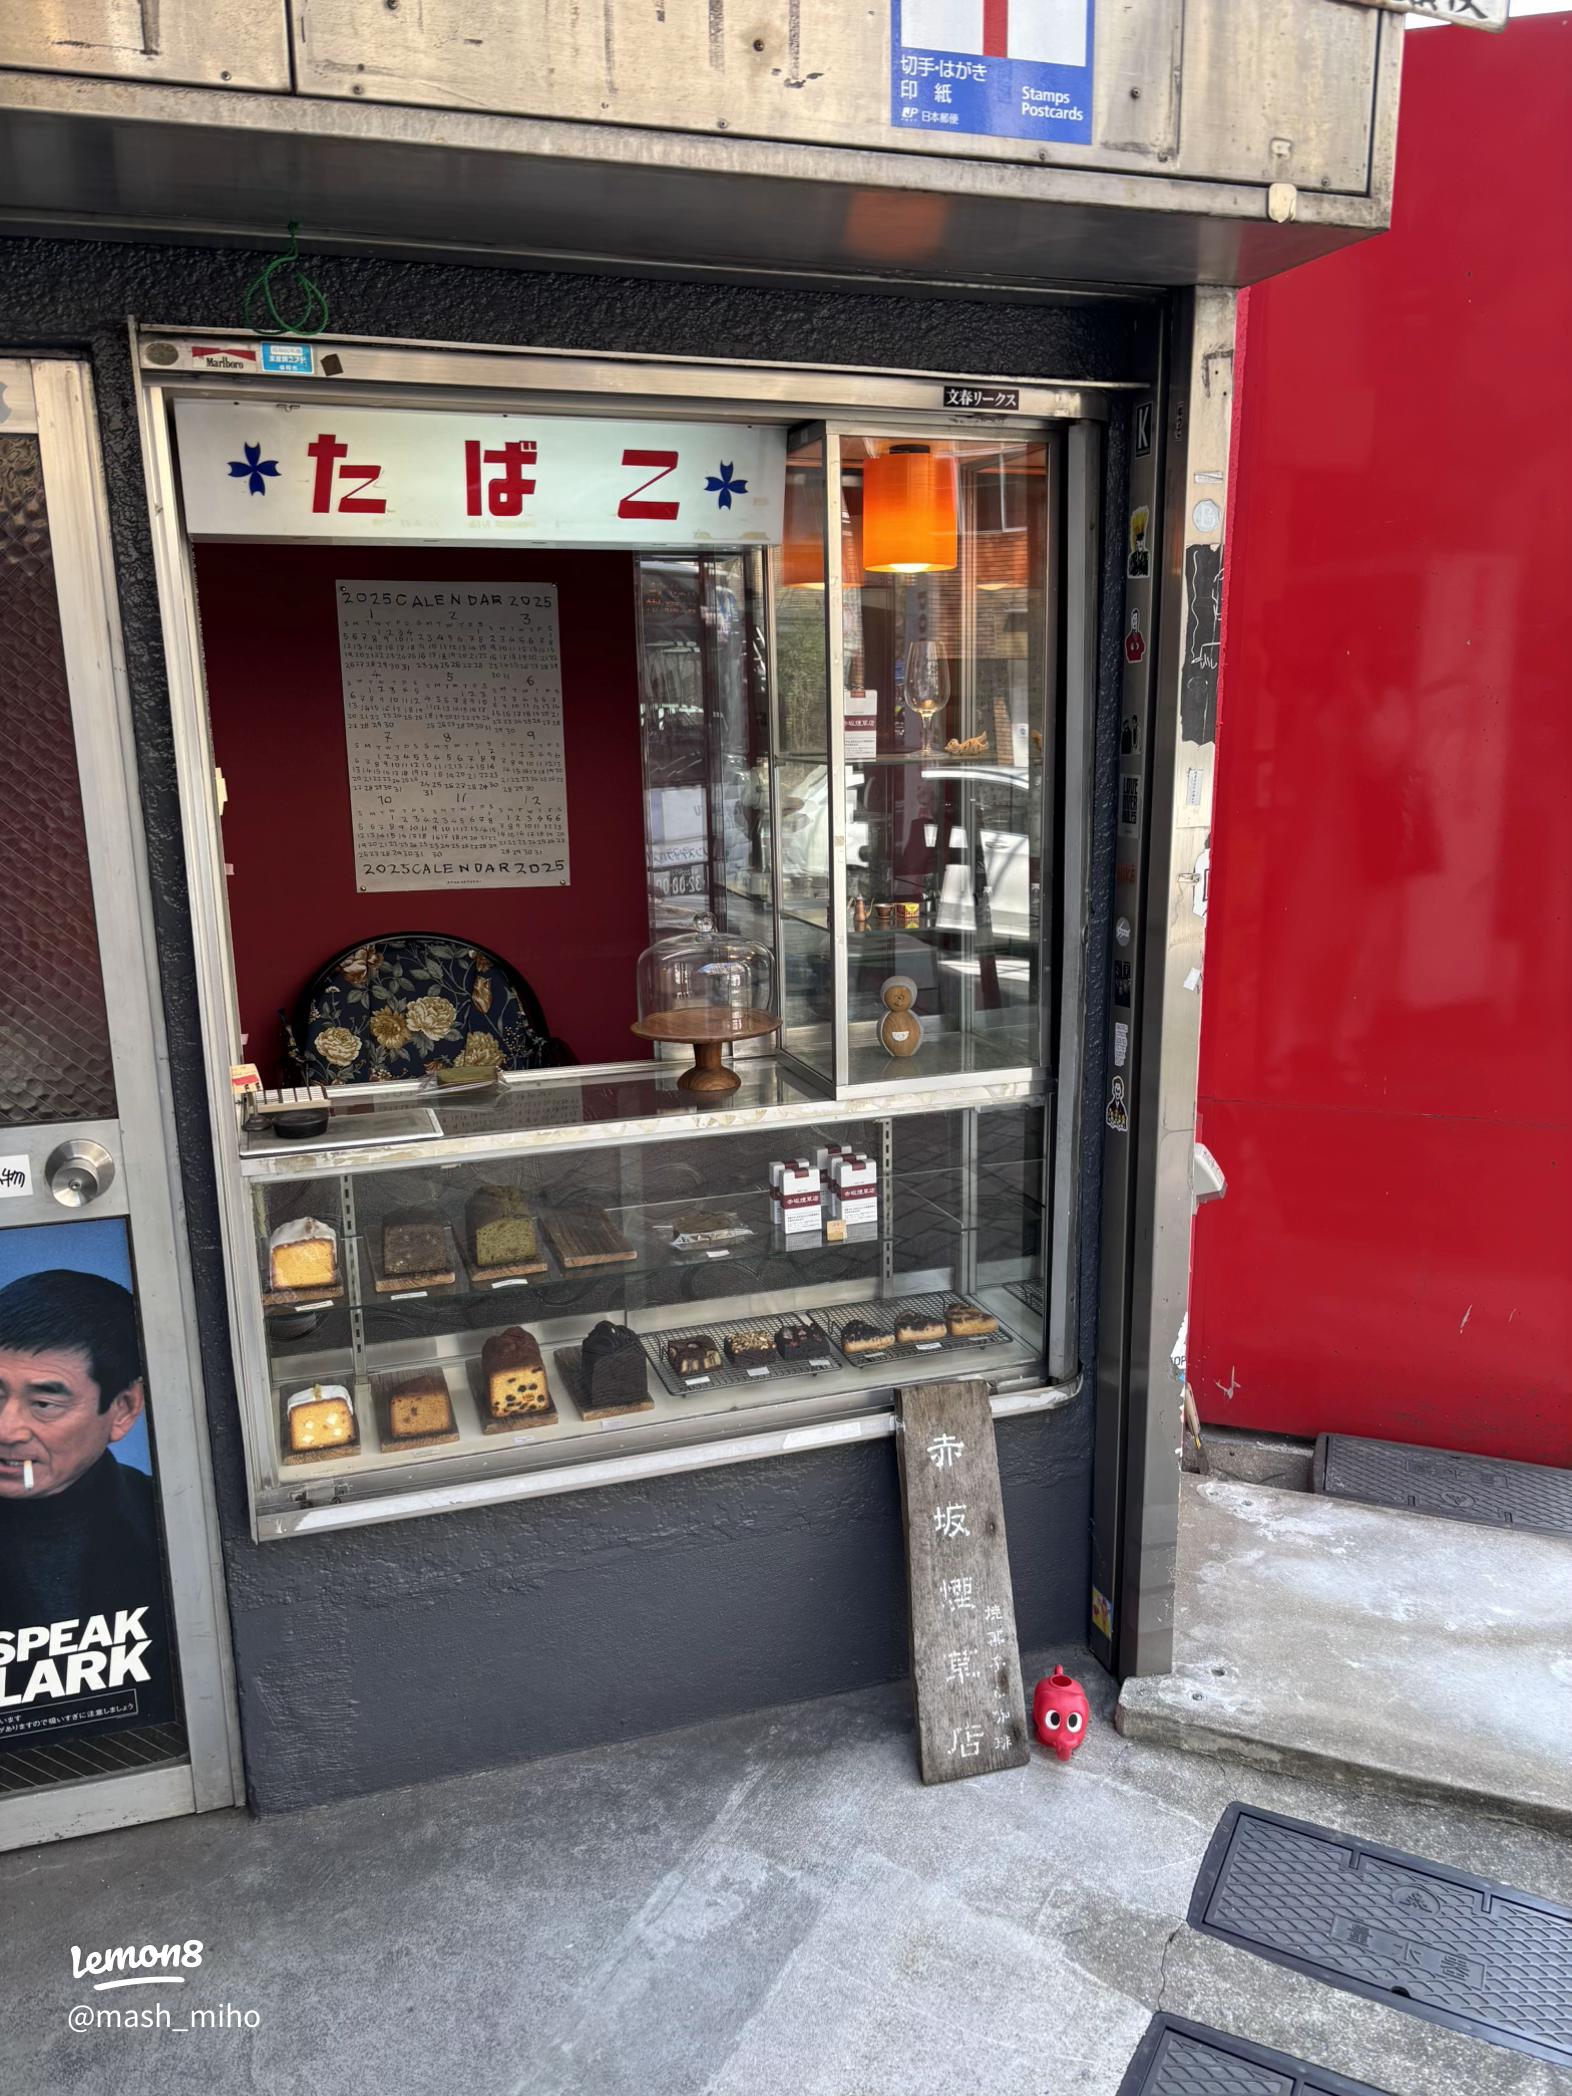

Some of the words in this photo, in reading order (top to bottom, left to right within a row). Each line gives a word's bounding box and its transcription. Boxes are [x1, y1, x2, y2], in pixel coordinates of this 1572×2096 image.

[900, 54, 987, 82] 切手・はがき
[1022, 86, 1070, 104] Stamps
[921, 110, 959, 125] 日本郵便
[1021, 102, 1084, 121] Postcards
[206, 357, 244, 370] Marlboro
[945, 389, 1017, 407] 文春リークス
[520, 613, 531, 625] 3
[447, 672, 454, 682] 5
[526, 675, 535, 686] 6
[384, 731, 392, 743] 7
[526, 731, 535, 741] 9
